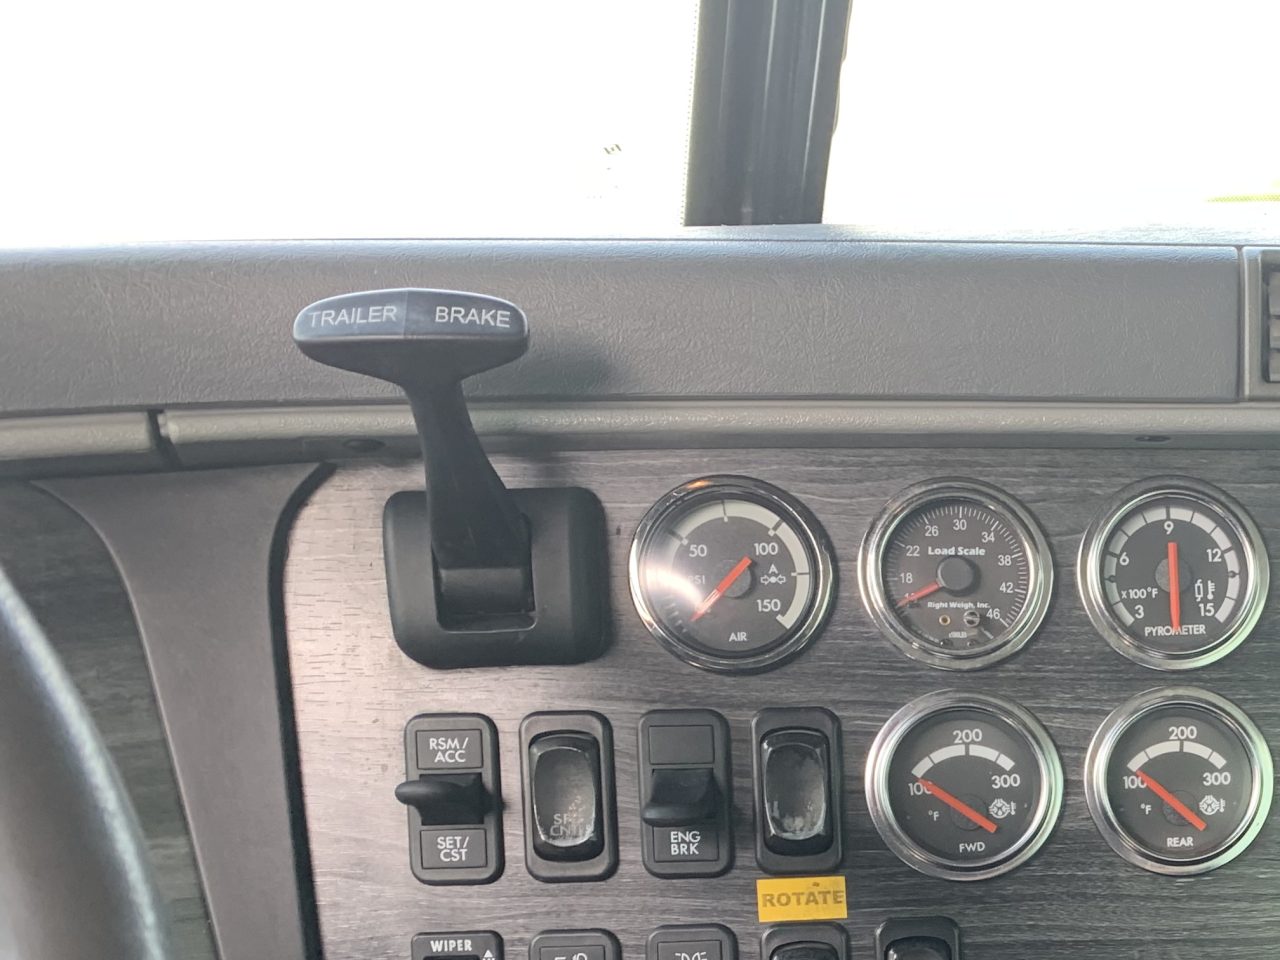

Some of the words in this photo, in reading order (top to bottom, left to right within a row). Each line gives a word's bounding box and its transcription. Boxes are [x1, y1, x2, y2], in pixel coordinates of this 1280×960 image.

[309, 306, 397, 328] TRAILER
[434, 306, 511, 328] BRAKE
[953, 519, 967, 530] 30
[1164, 521, 1174, 535] 9
[925, 526, 939, 537] 26
[981, 532, 995, 543] 34
[689, 545, 708, 558] 50
[754, 543, 779, 556] 100
[906, 546, 920, 557] 22
[928, 547, 955, 556] Load
[958, 547, 986, 556] Scale
[1207, 549, 1222, 562] 12
[998, 555, 1011, 566] 38
[1119, 552, 1129, 566] 6
[900, 573, 913, 583] 18
[1000, 582, 1014, 593] 42
[757, 599, 781, 612] 150
[1135, 605, 1144, 618] 3
[1199, 603, 1215, 616] 15
[986, 609, 1000, 620] 46
[729, 632, 748, 642] AIR
[953, 729, 982, 743] 200
[1169, 726, 1197, 739] 200
[434, 752, 466, 763] ACC
[992, 774, 1020, 789] 300
[1203, 772, 1231, 785] 300
[671, 832, 700, 842] ENG
[1167, 837, 1193, 847] REAR
[671, 844, 699, 855] BRK
[959, 842, 985, 853] FWD
[440, 850, 468, 862] CST
[762, 890, 845, 908] ROTATE
[430, 939, 472, 952] WIPER
